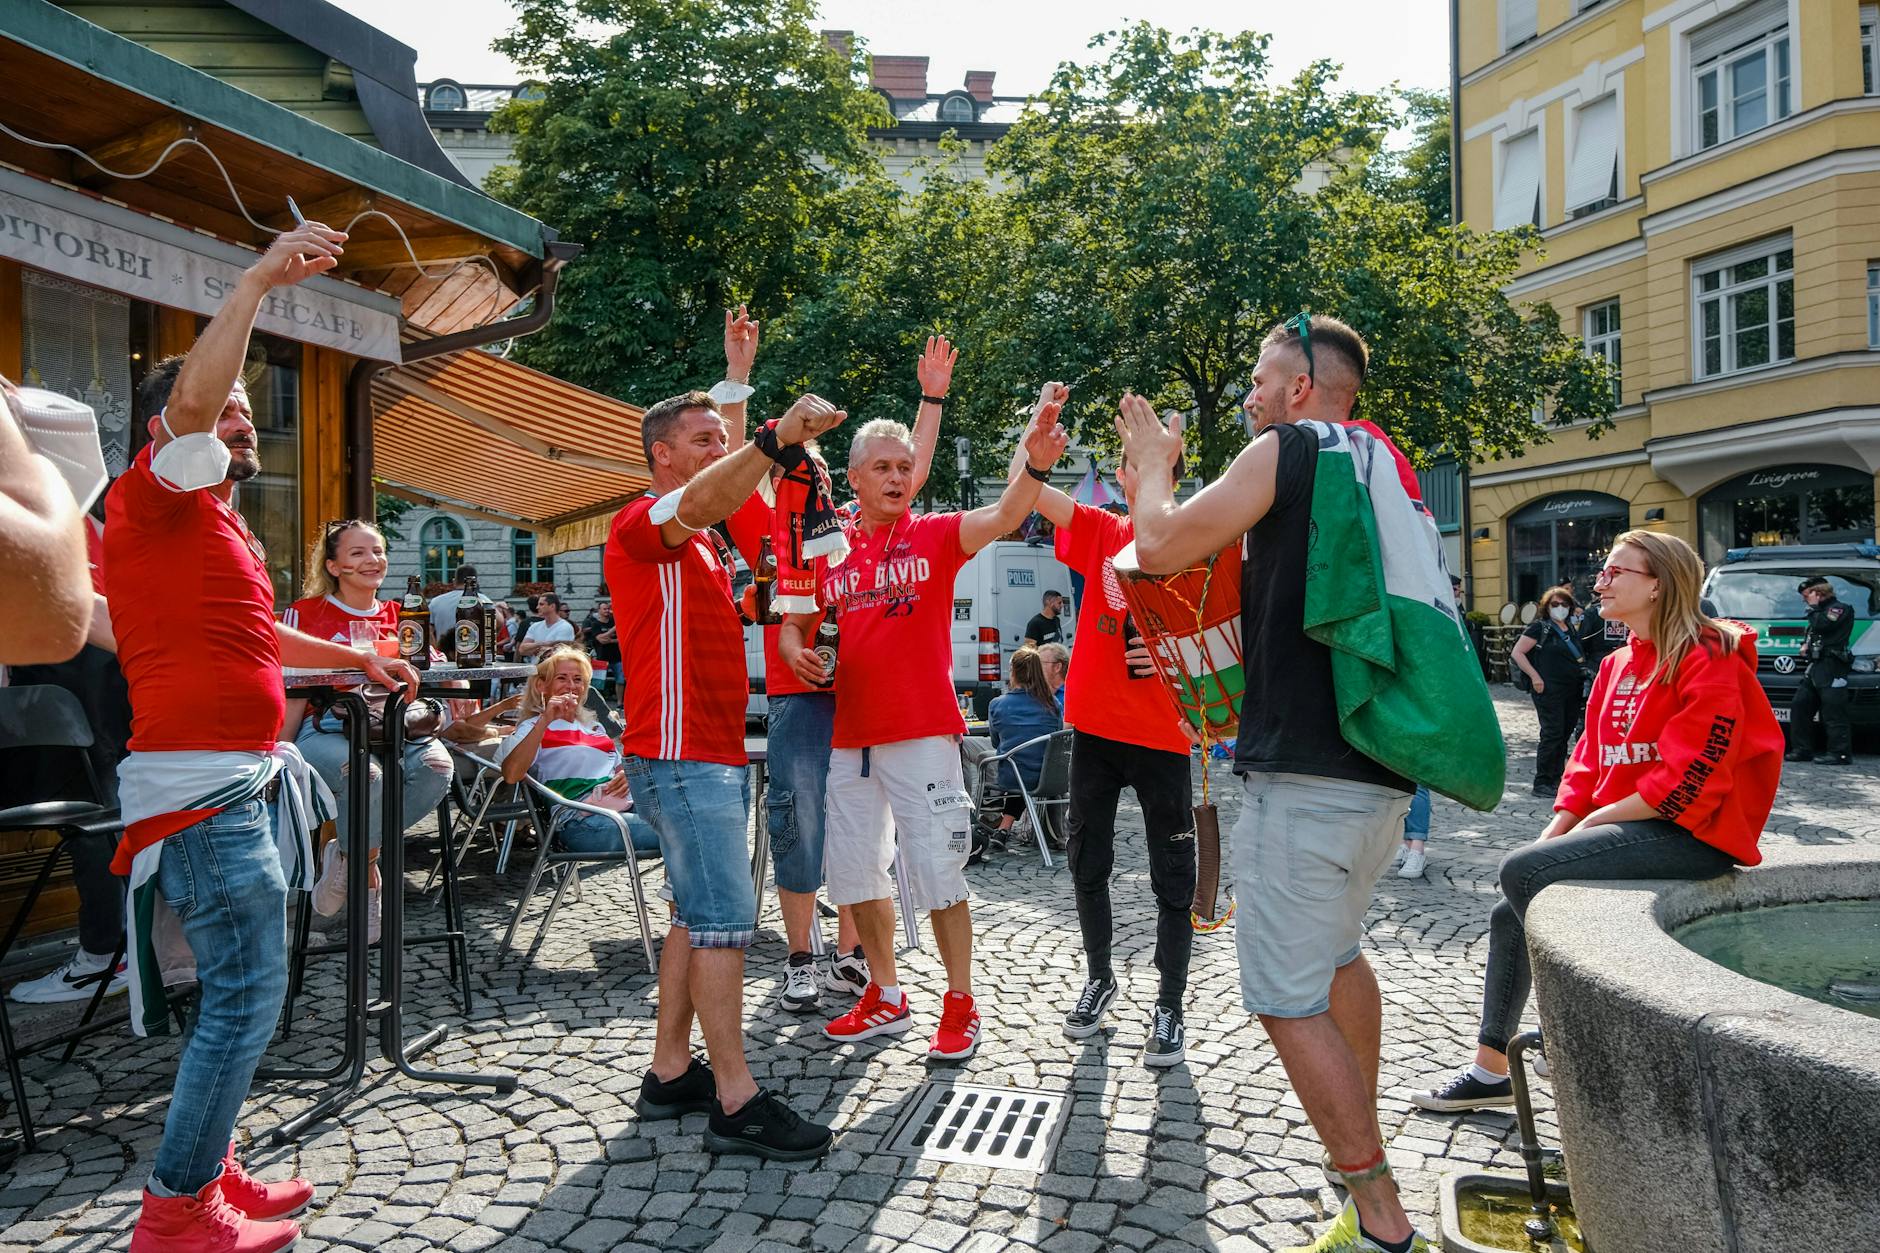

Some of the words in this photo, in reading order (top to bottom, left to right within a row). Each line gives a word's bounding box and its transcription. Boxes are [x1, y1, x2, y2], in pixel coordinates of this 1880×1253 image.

[204, 276, 364, 341] SHCAFE
[1748, 471, 1820, 488] Livingroom
[1543, 499, 1592, 514] Livingroom
[875, 557, 931, 589] DAVID
